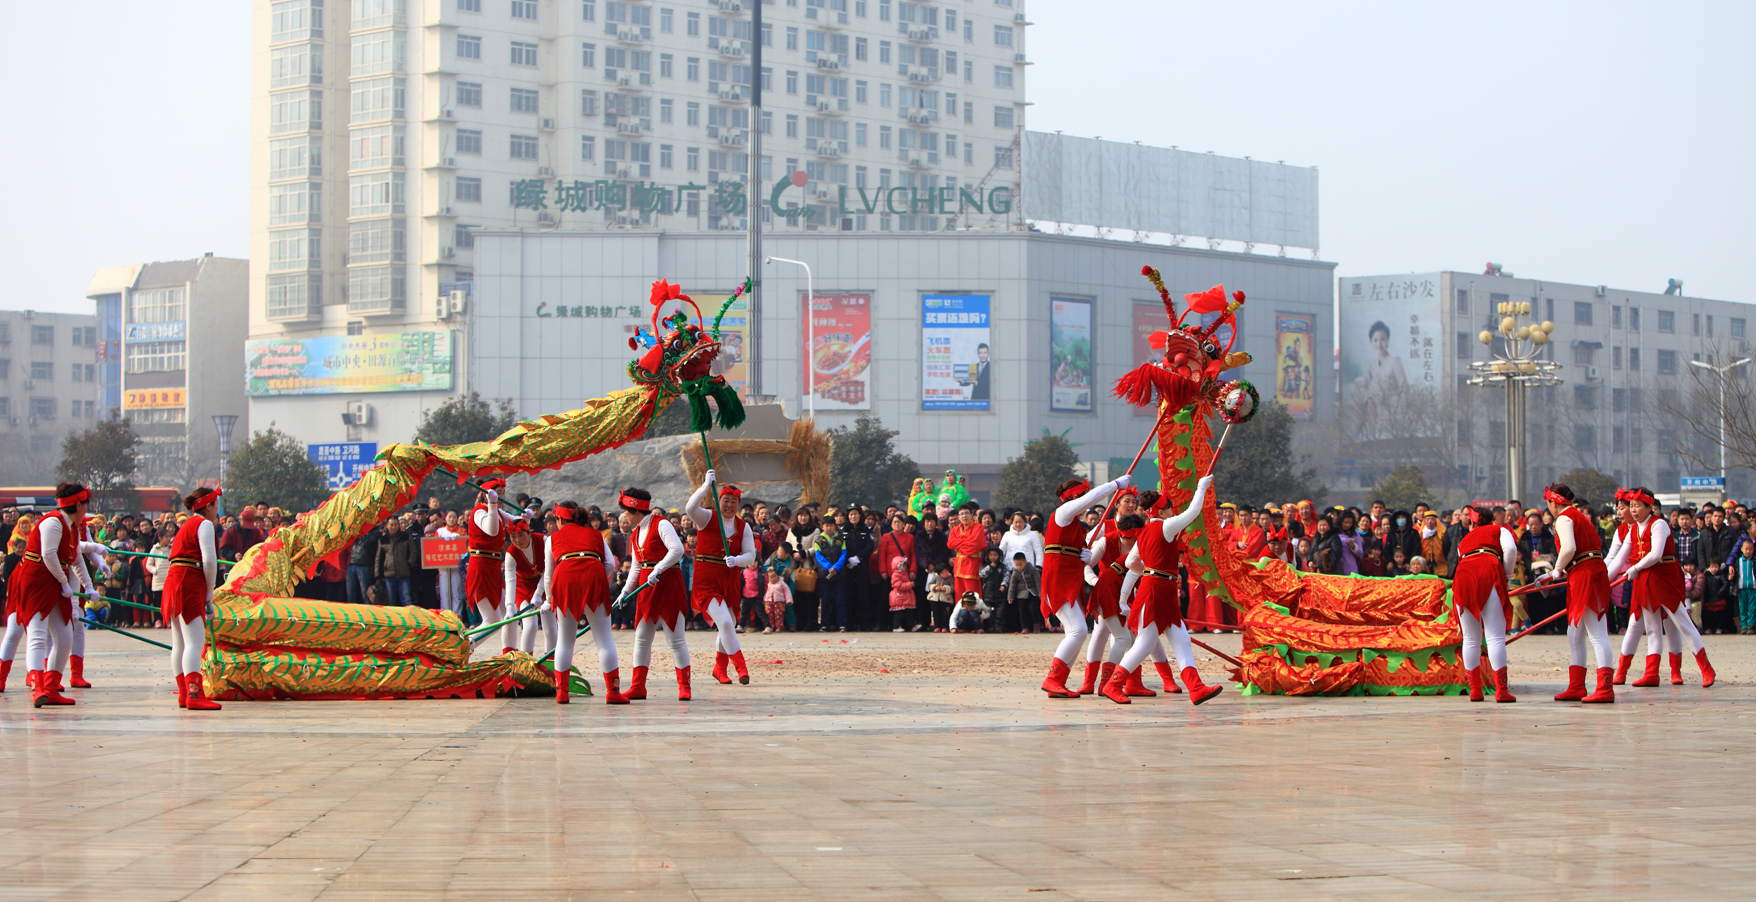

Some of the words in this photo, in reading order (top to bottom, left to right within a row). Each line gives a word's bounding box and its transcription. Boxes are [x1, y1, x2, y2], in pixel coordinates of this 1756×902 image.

[513, 179, 748, 213] 绿城购物广场
[839, 186, 1012, 215] LVCHENG
[1369, 280, 1435, 300] 左右沙发
[556, 305, 641, 318] 绿城购物广场
